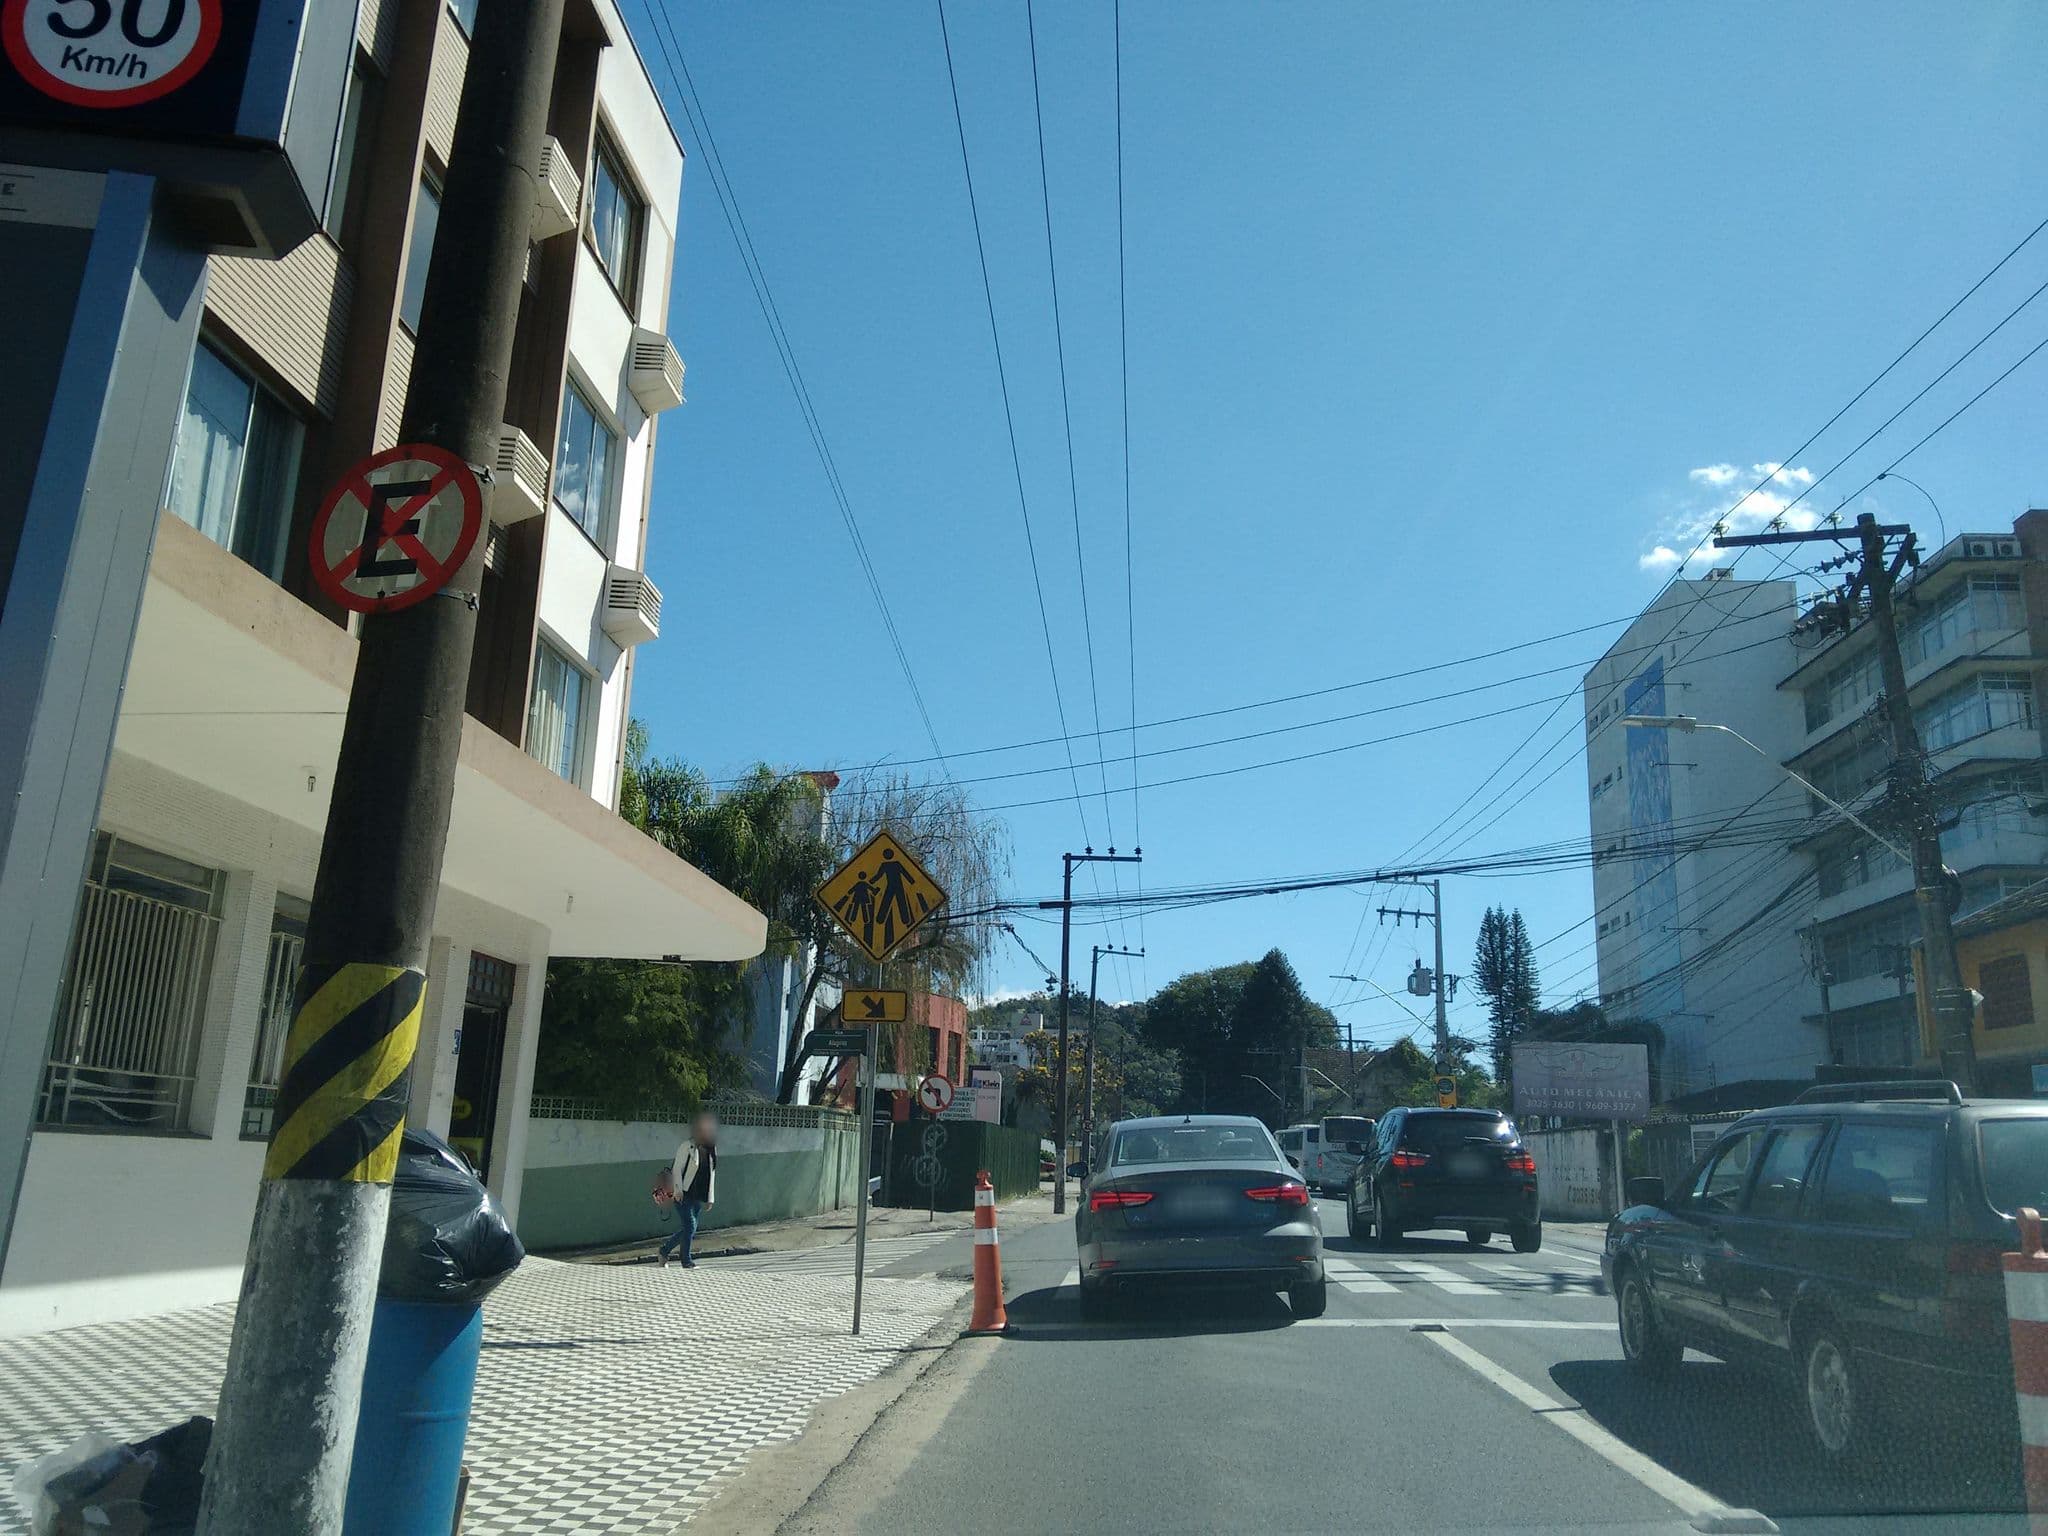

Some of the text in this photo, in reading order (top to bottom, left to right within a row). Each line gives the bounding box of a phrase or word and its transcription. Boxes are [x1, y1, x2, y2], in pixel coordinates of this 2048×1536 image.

[60, 45, 148, 80] Km/h
[355, 479, 433, 578] E
[983, 1079, 1000, 1089] Klein
[1519, 1087, 1559, 1096] AUTO
